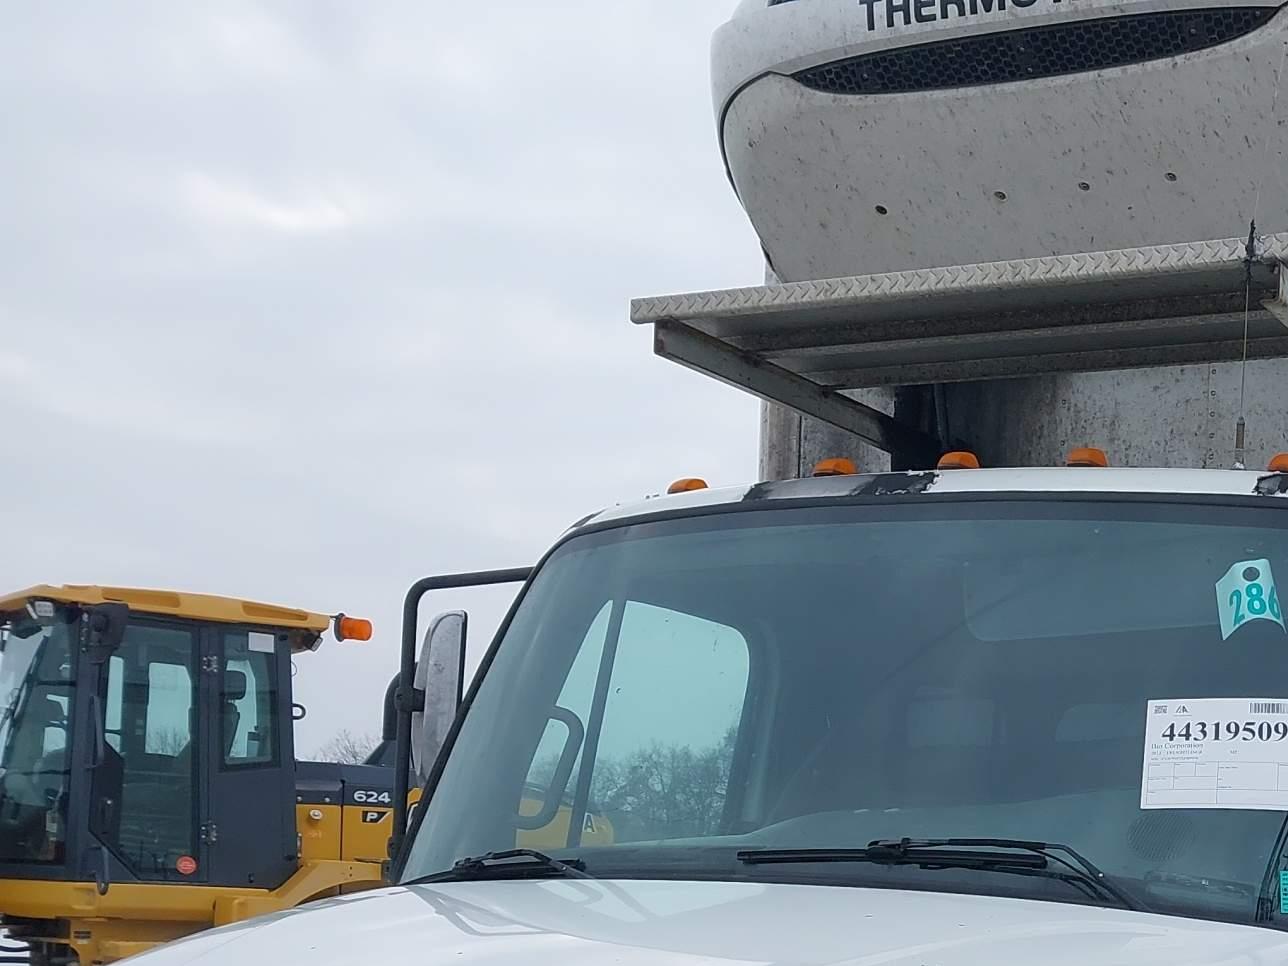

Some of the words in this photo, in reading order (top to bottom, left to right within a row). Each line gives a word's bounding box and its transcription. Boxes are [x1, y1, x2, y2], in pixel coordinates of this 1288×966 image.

[1161, 720, 1288, 742] 44319509
[353, 790, 391, 804] 624
[366, 812, 378, 822] P
